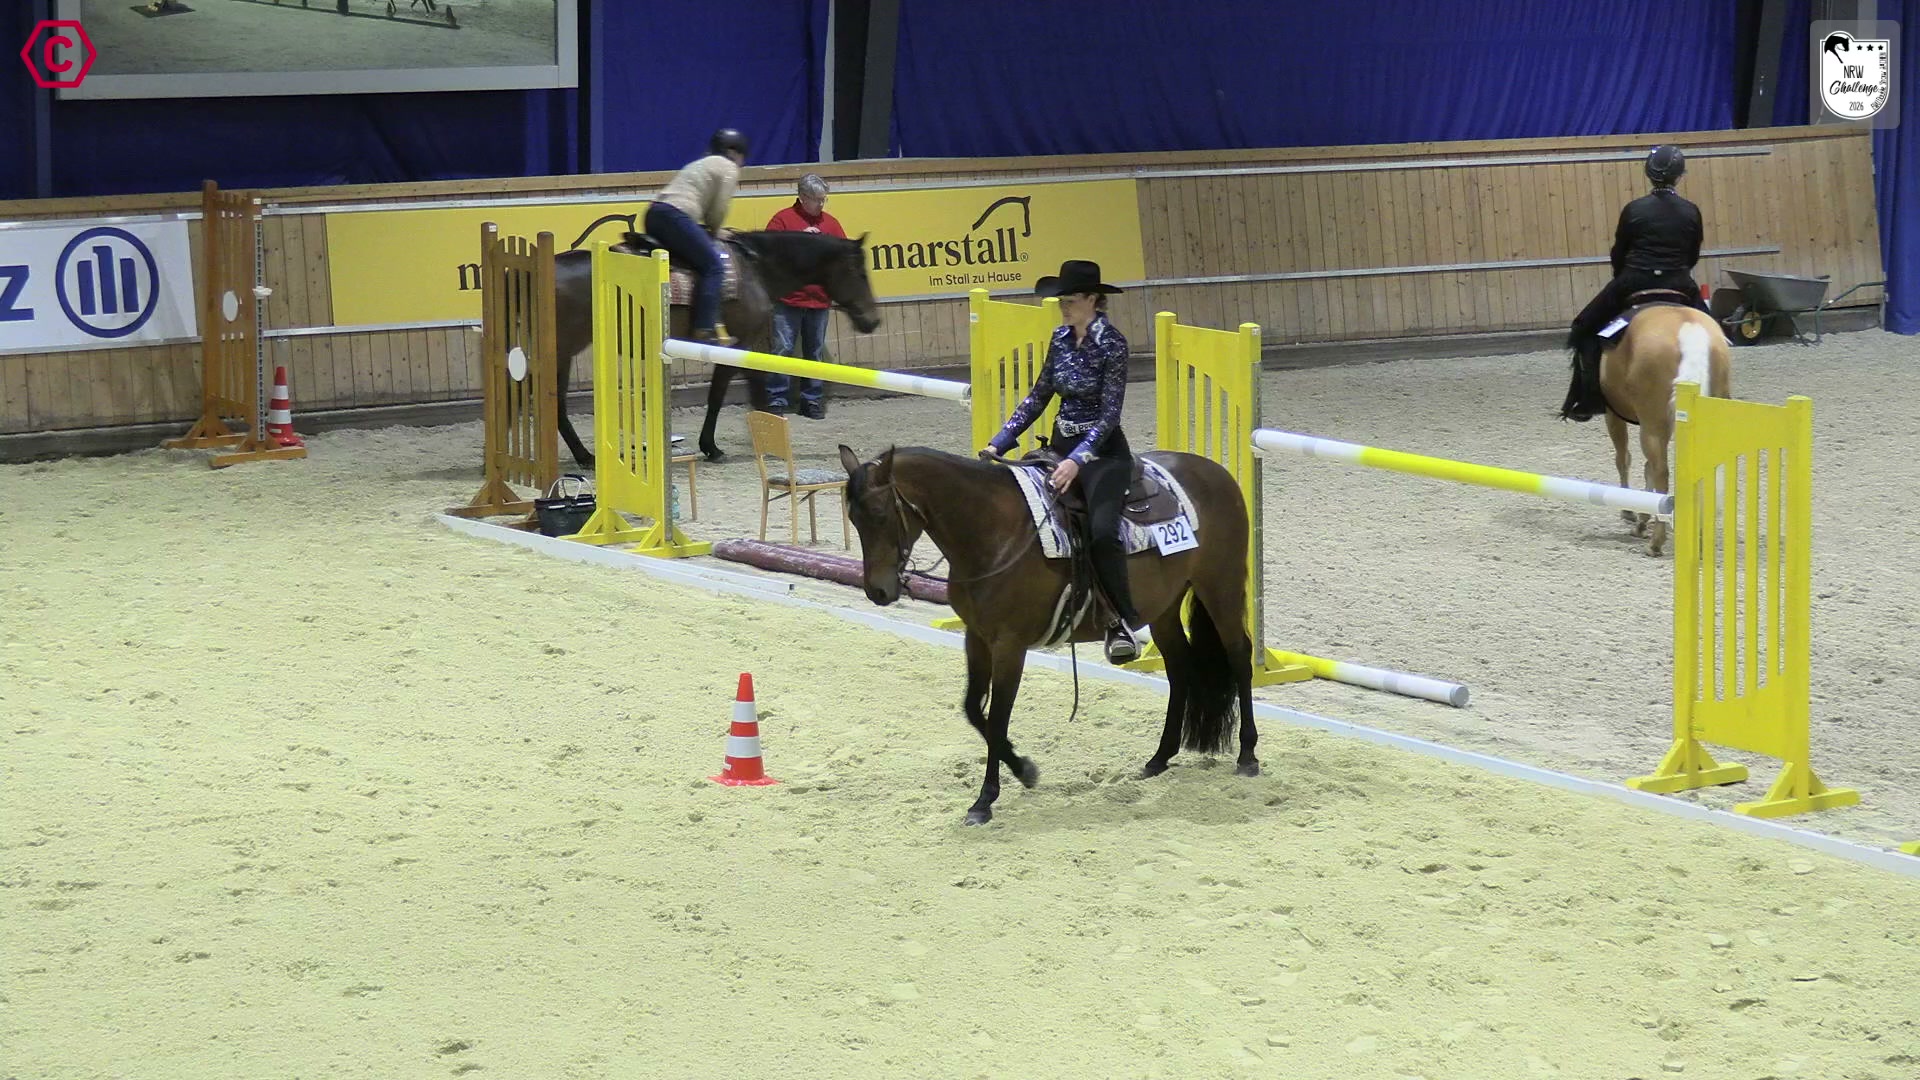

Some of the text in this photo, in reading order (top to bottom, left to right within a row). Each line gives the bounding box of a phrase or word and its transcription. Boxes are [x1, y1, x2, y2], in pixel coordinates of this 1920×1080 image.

[929, 271, 1022, 286] Im Stall zu Hause
[1158, 521, 1188, 545] 292
